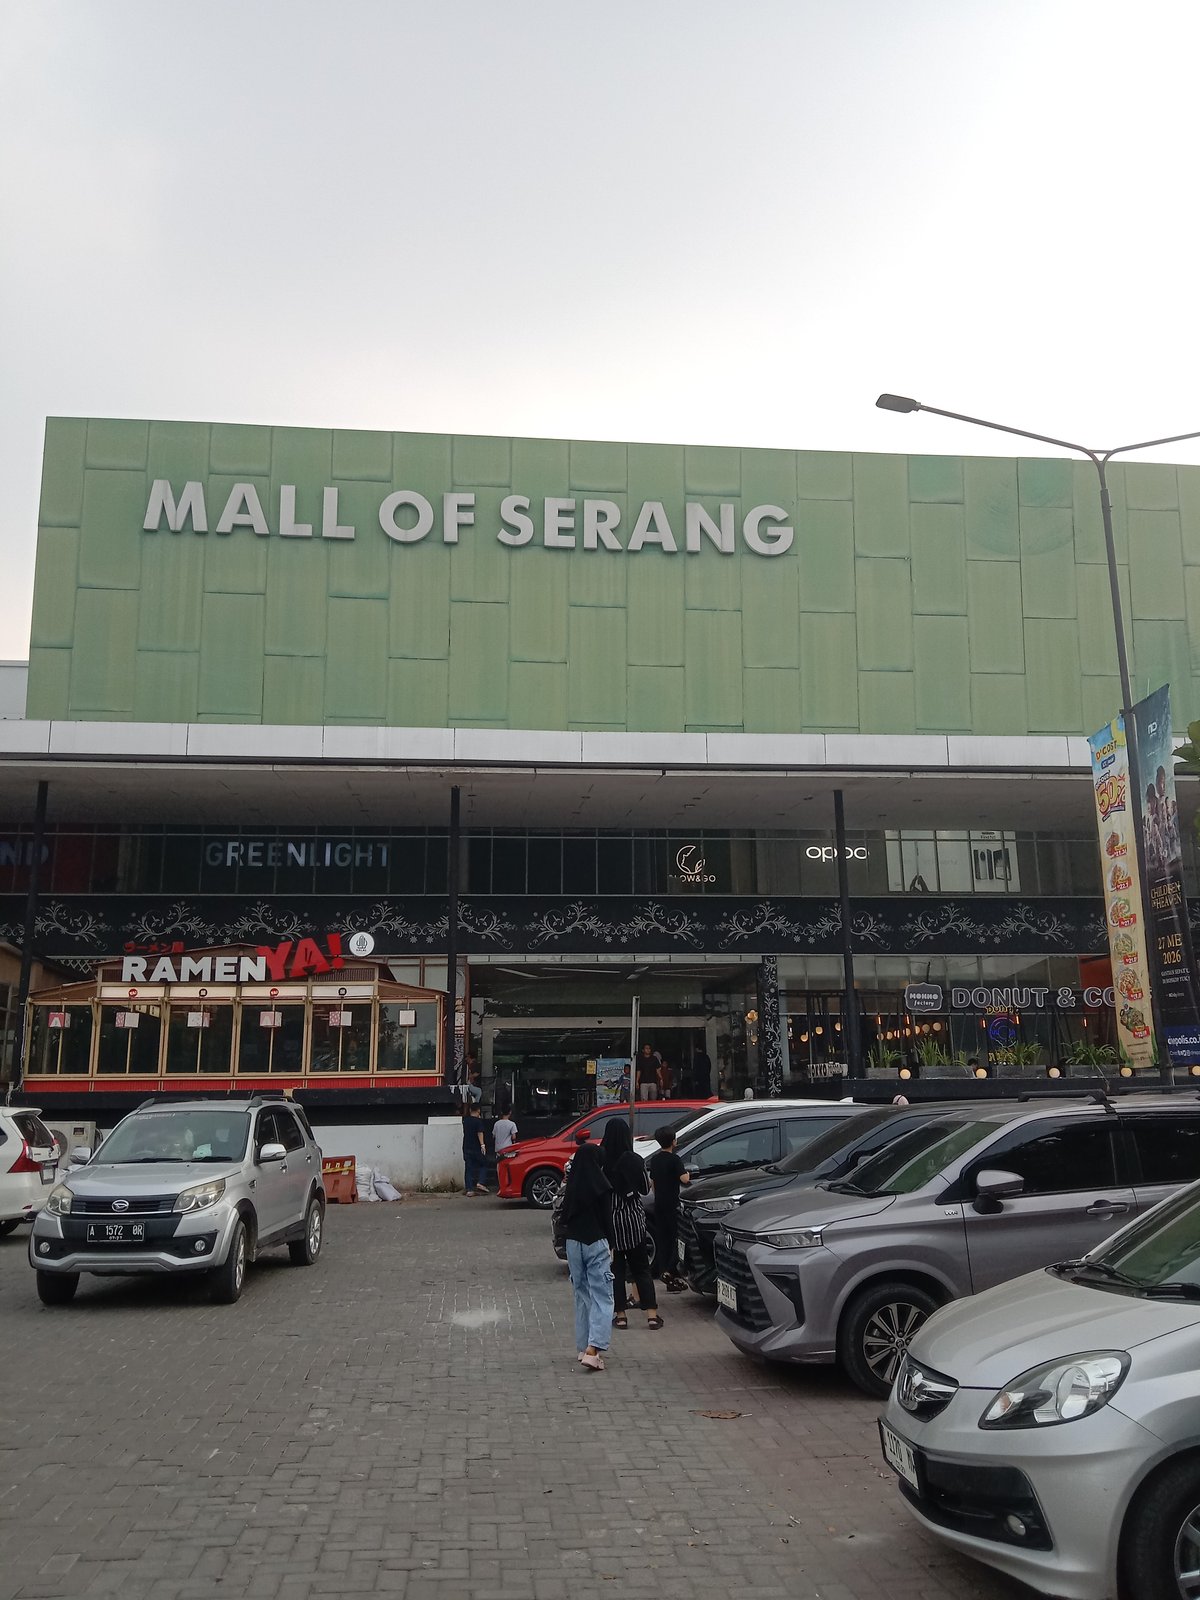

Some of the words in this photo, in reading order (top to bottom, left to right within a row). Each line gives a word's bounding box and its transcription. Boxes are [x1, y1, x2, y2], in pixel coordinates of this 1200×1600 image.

[142, 479, 356, 541] MALL
[378, 488, 476, 546] OF
[496, 493, 796, 558] SERANG
[205, 841, 390, 868] GREENLIGHT
[1151, 880, 1182, 900] CHILDREN
[1156, 892, 1183, 910] HEAVEN
[1157, 936, 1166, 950] 27
[121, 956, 266, 983] RAMEN
[256, 932, 346, 982] YA!
[1162, 949, 1182, 965] 2026
[952, 987, 1049, 1008] DONUT
[1056, 986, 1076, 1008] &
[89, 1225, 95, 1236] A
[105, 1224, 124, 1236] 1572
